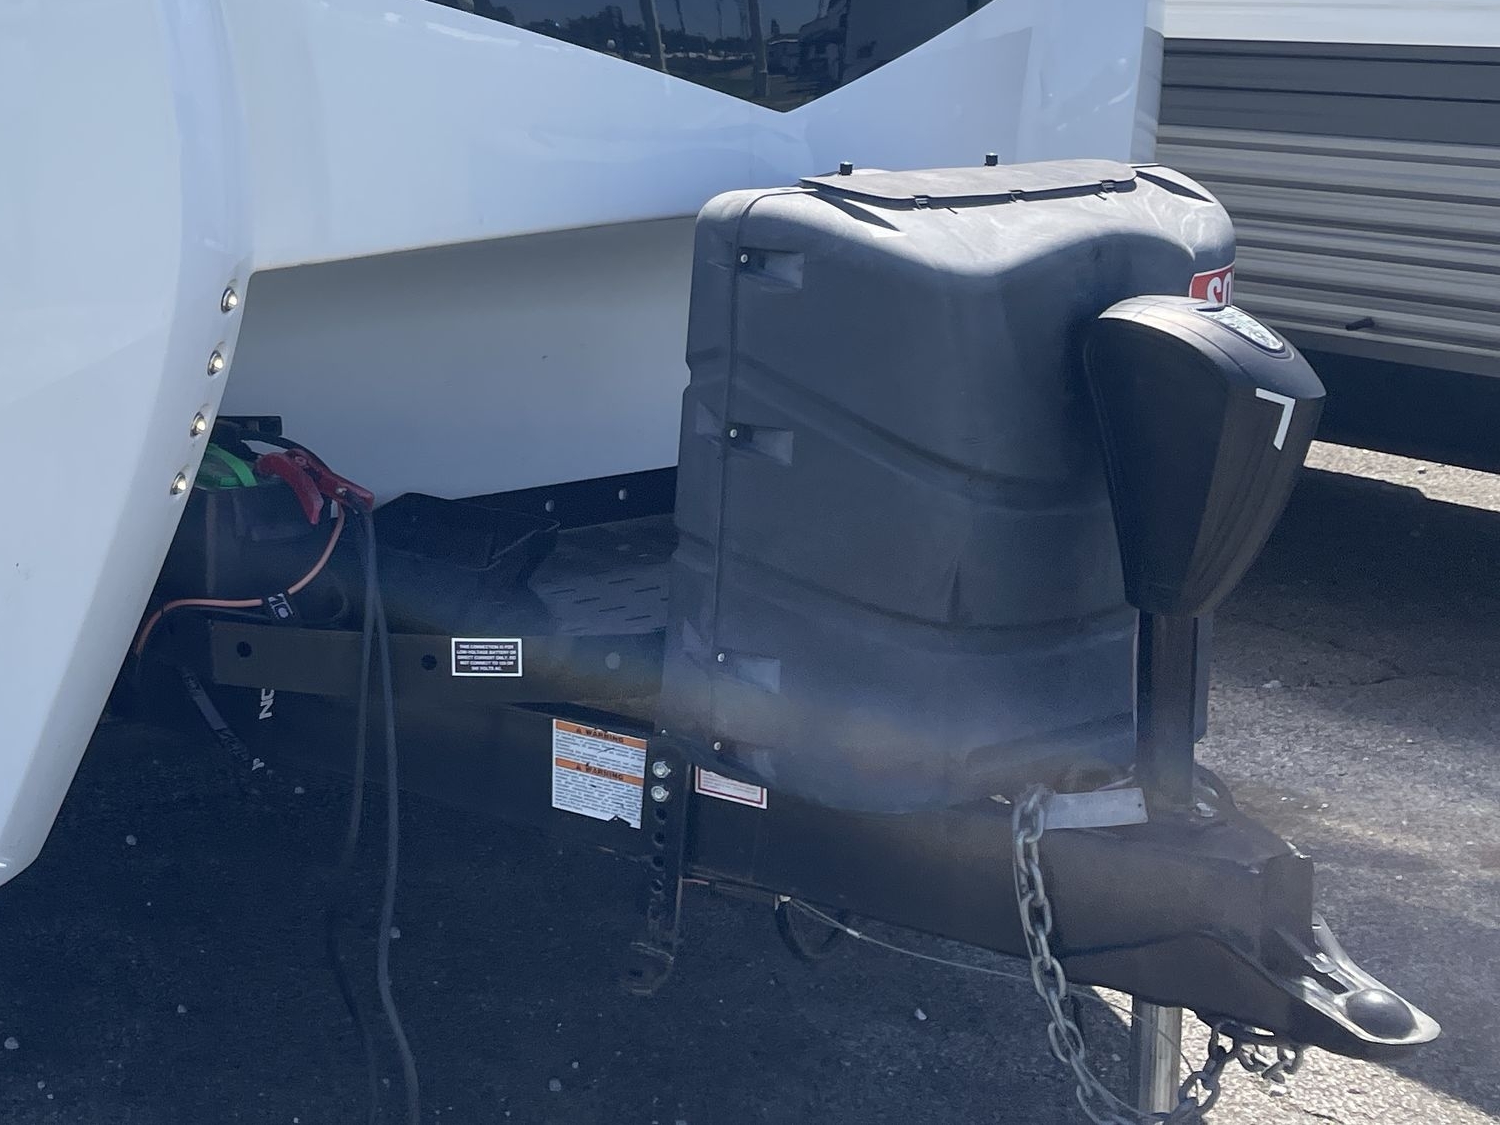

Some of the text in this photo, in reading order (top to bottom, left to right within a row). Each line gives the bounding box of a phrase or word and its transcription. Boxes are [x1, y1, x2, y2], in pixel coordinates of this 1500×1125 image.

[1256, 388, 1296, 451] 7
[586, 729, 623, 743] WARNING
[586, 766, 623, 780] WARNING
